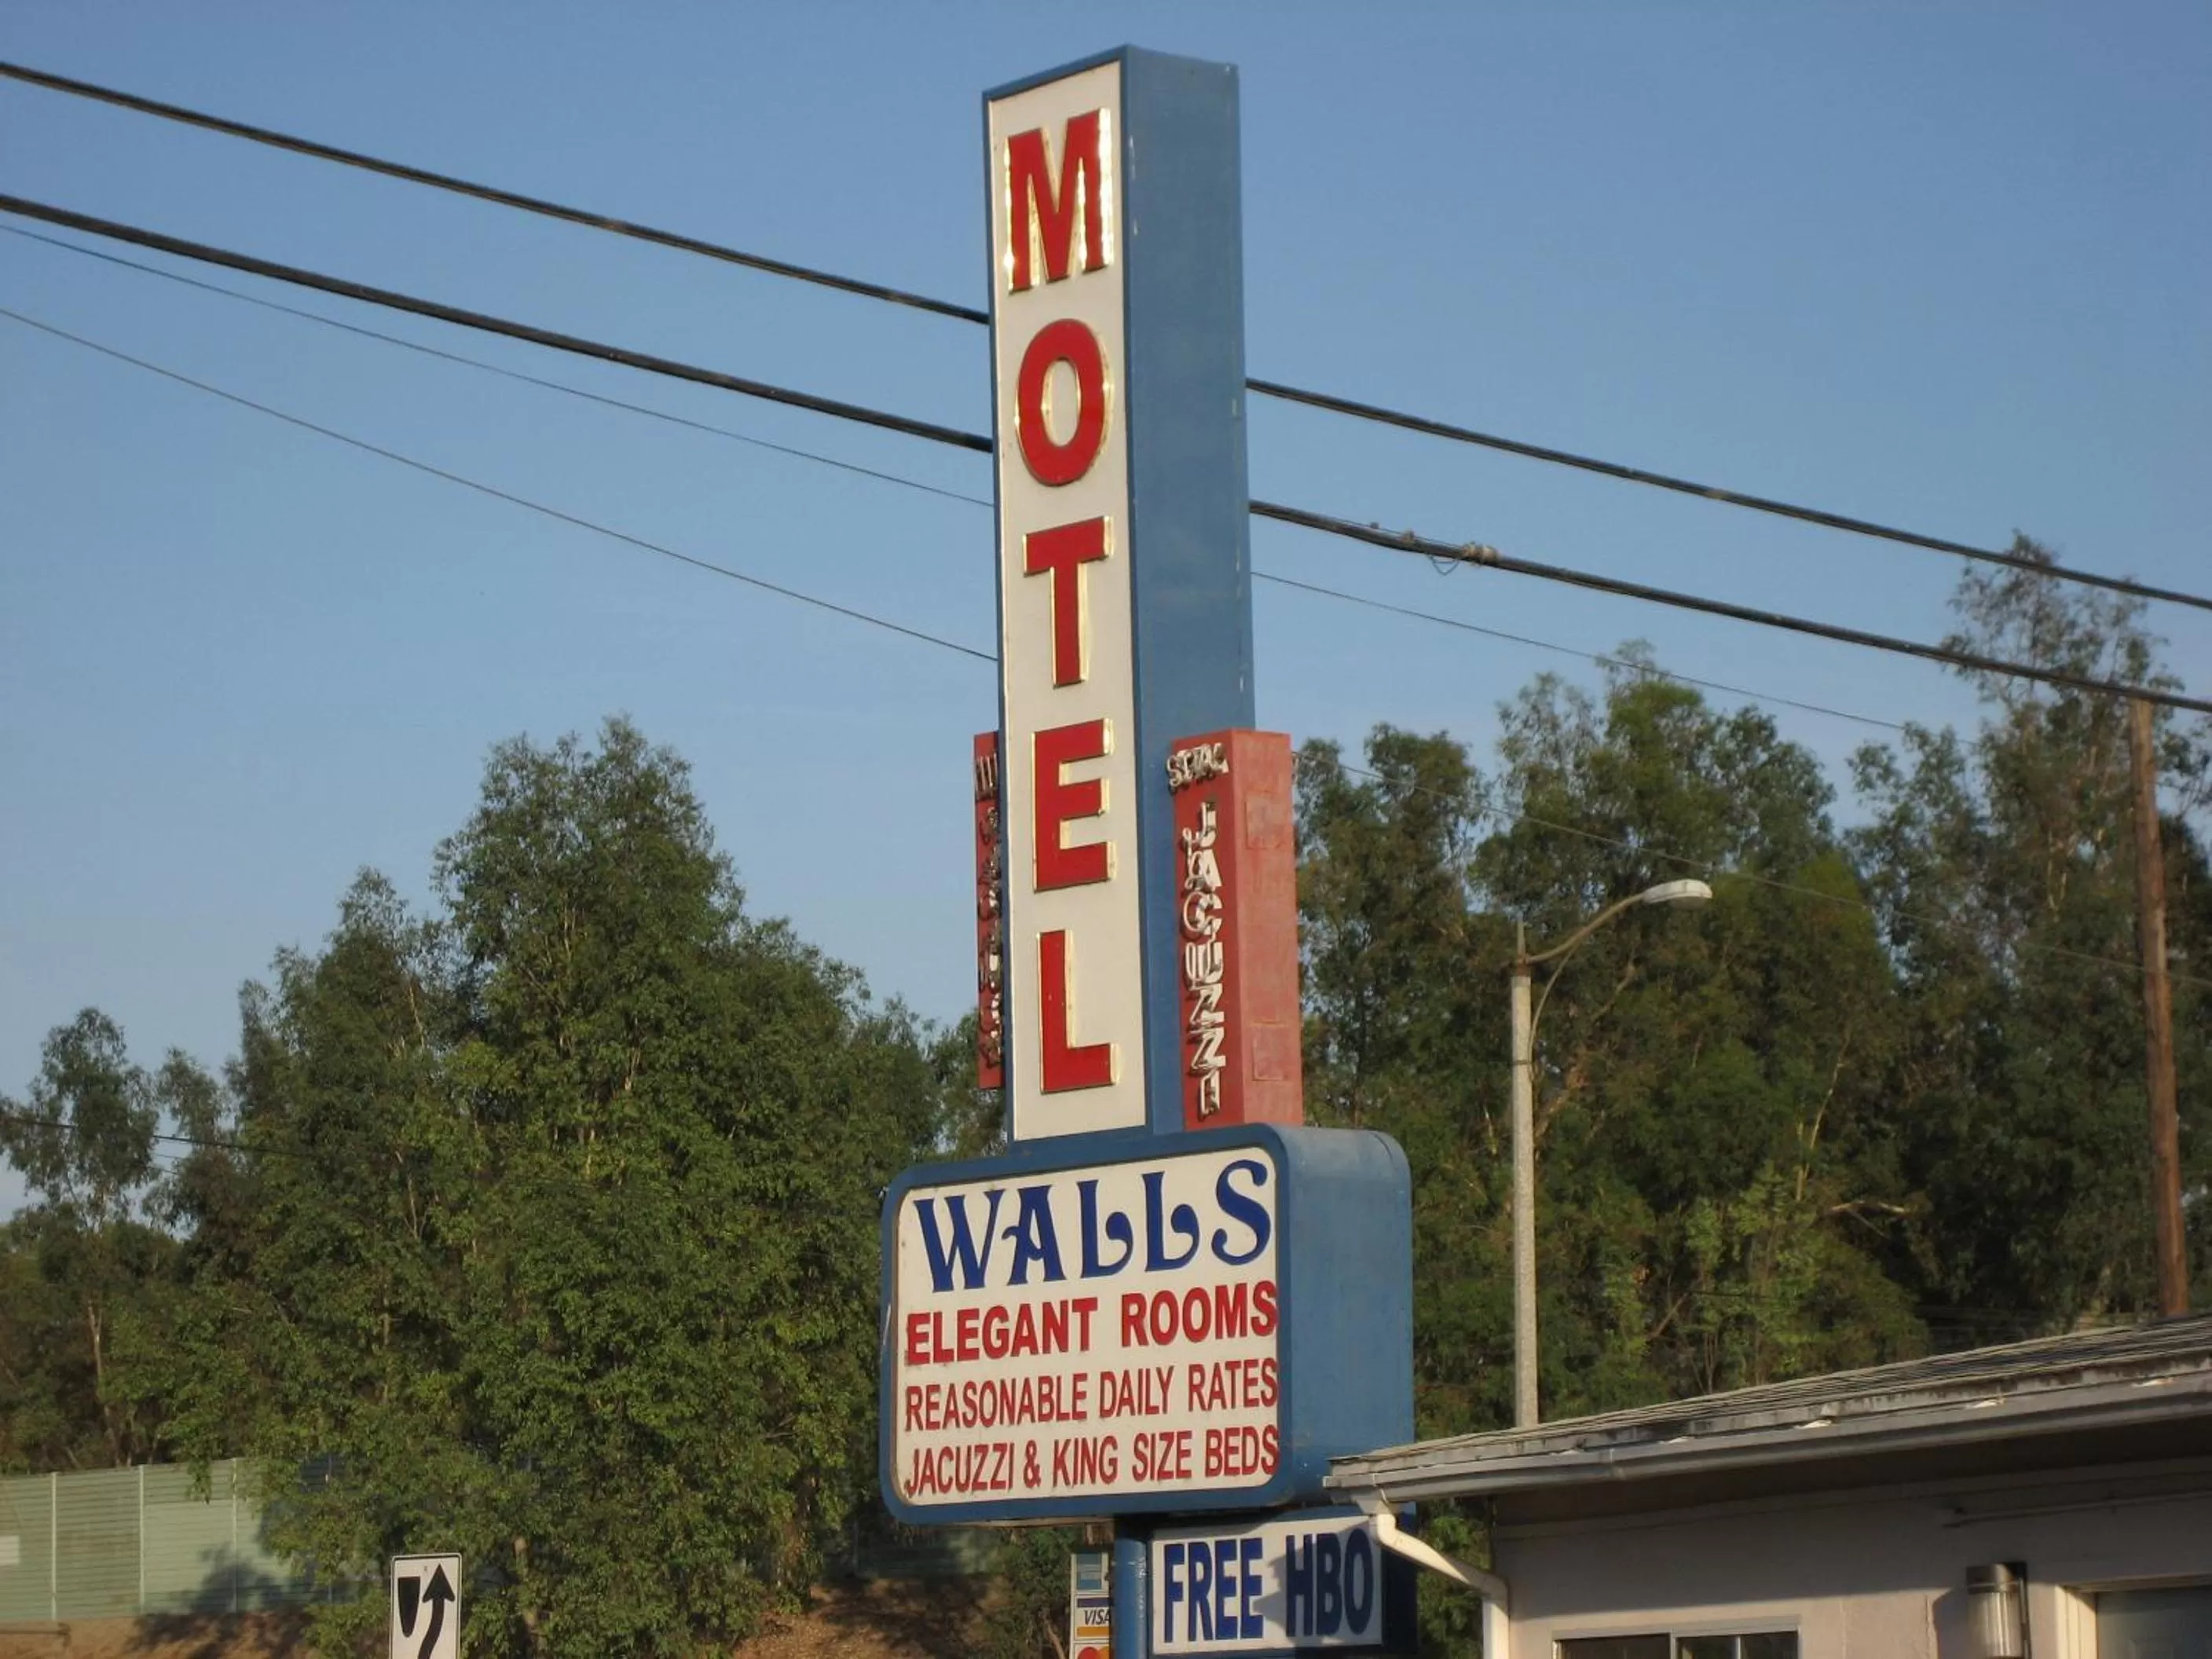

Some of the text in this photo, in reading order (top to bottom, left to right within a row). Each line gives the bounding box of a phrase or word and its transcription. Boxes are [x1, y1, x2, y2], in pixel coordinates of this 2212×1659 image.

[1005, 108, 1119, 1093] MOTEL
[914, 1160, 1271, 1292] WALLS
[906, 1280, 1279, 1366] ELEGANT ROOMS
[906, 1357, 1279, 1431] REASONABLE DAILY RATES
[905, 1425, 1280, 1496] JACUZZI & KING SIZE BEDS
[1163, 1529, 1374, 1643] FREE HBO
